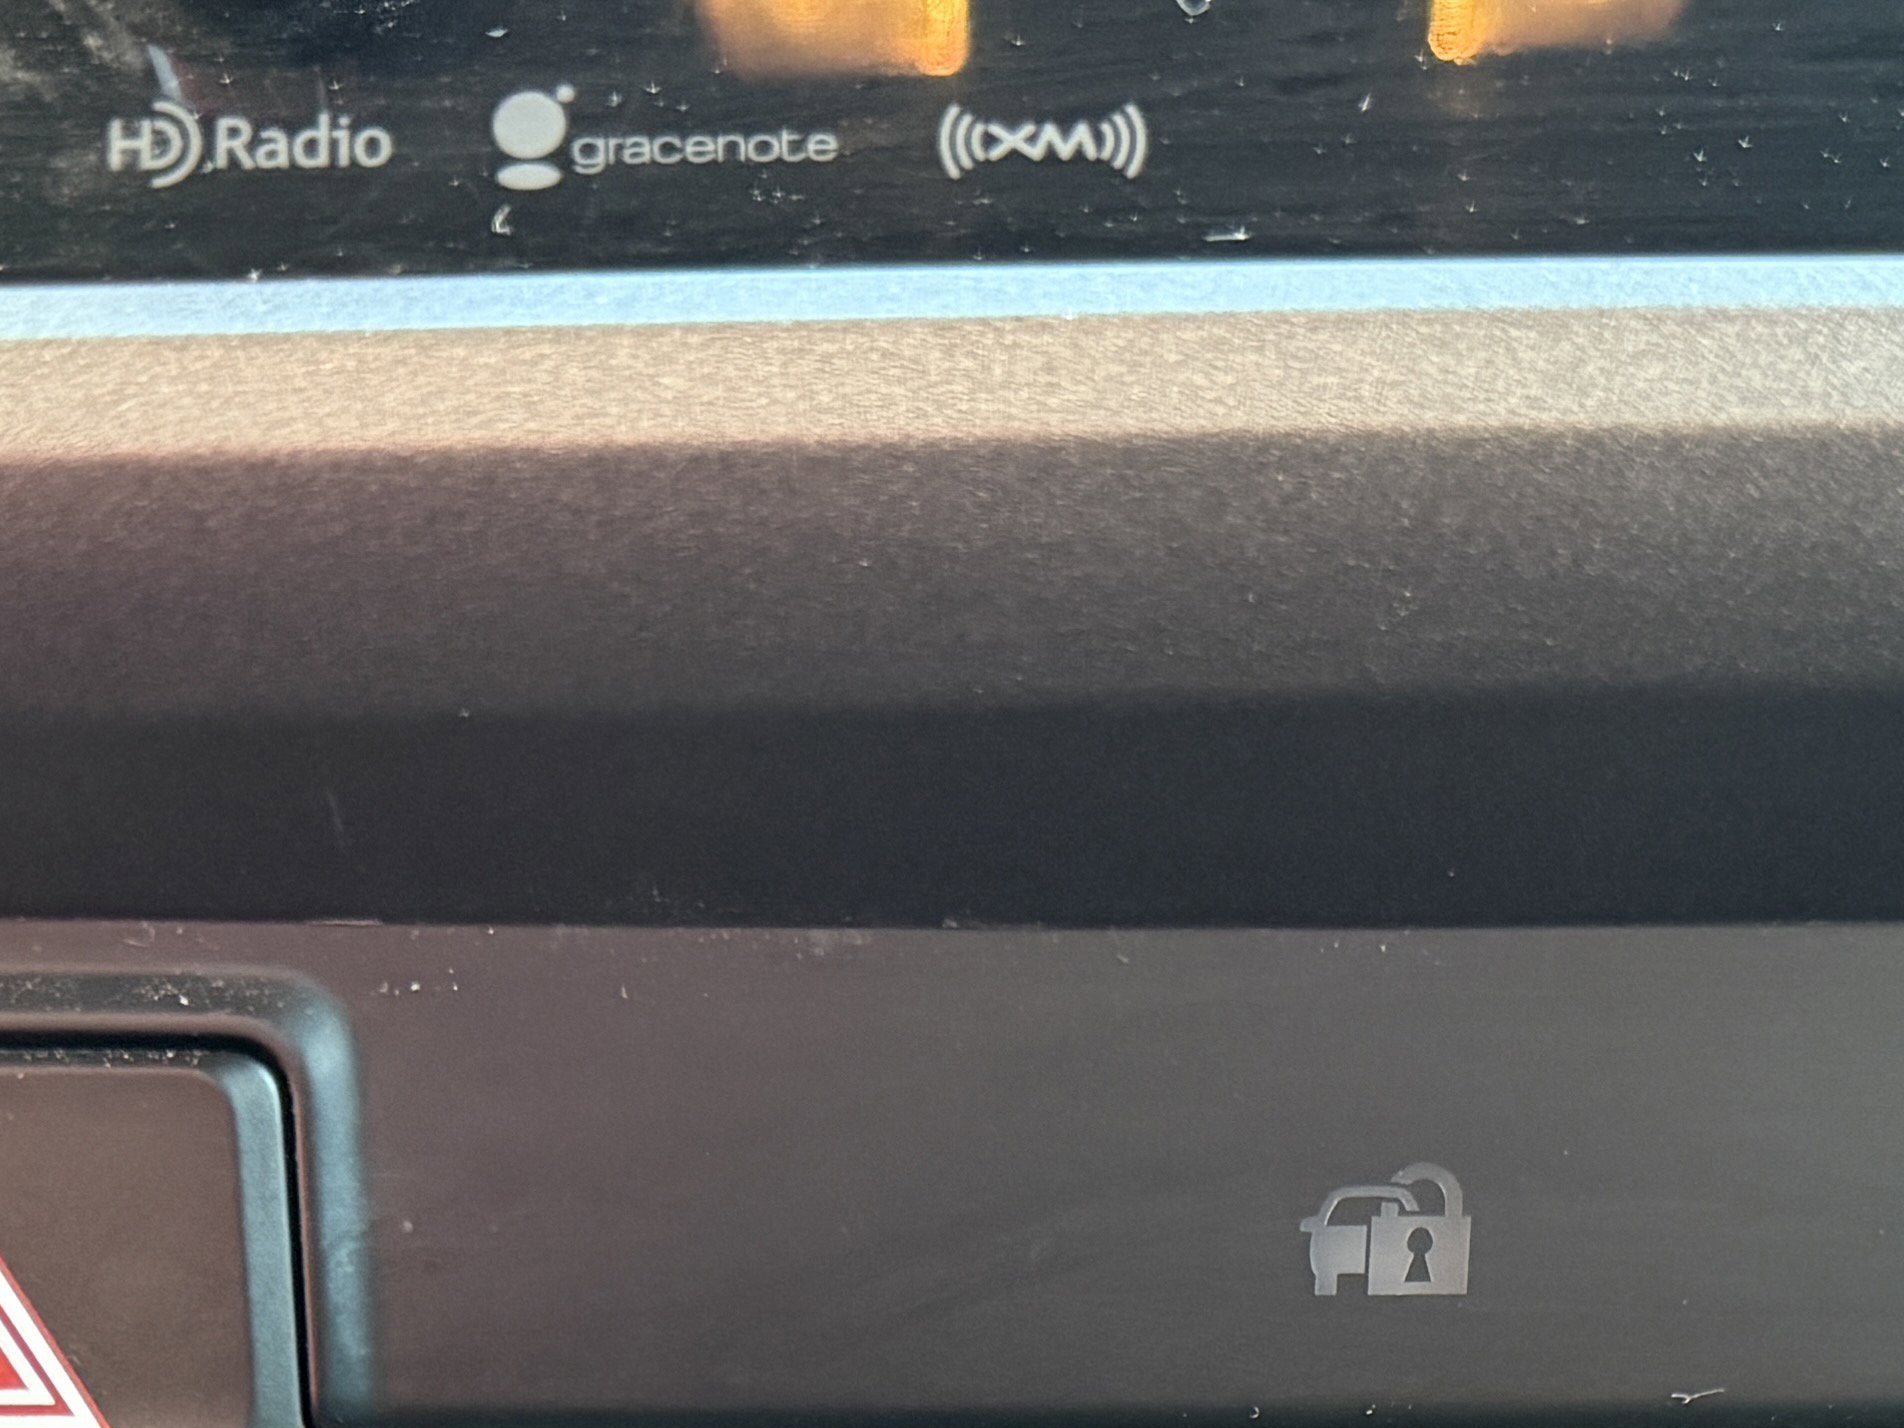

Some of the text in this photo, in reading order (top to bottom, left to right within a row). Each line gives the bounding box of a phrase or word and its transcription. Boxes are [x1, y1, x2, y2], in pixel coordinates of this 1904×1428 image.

[106, 110, 393, 180] HD Radio
[571, 127, 839, 173] gracenote
